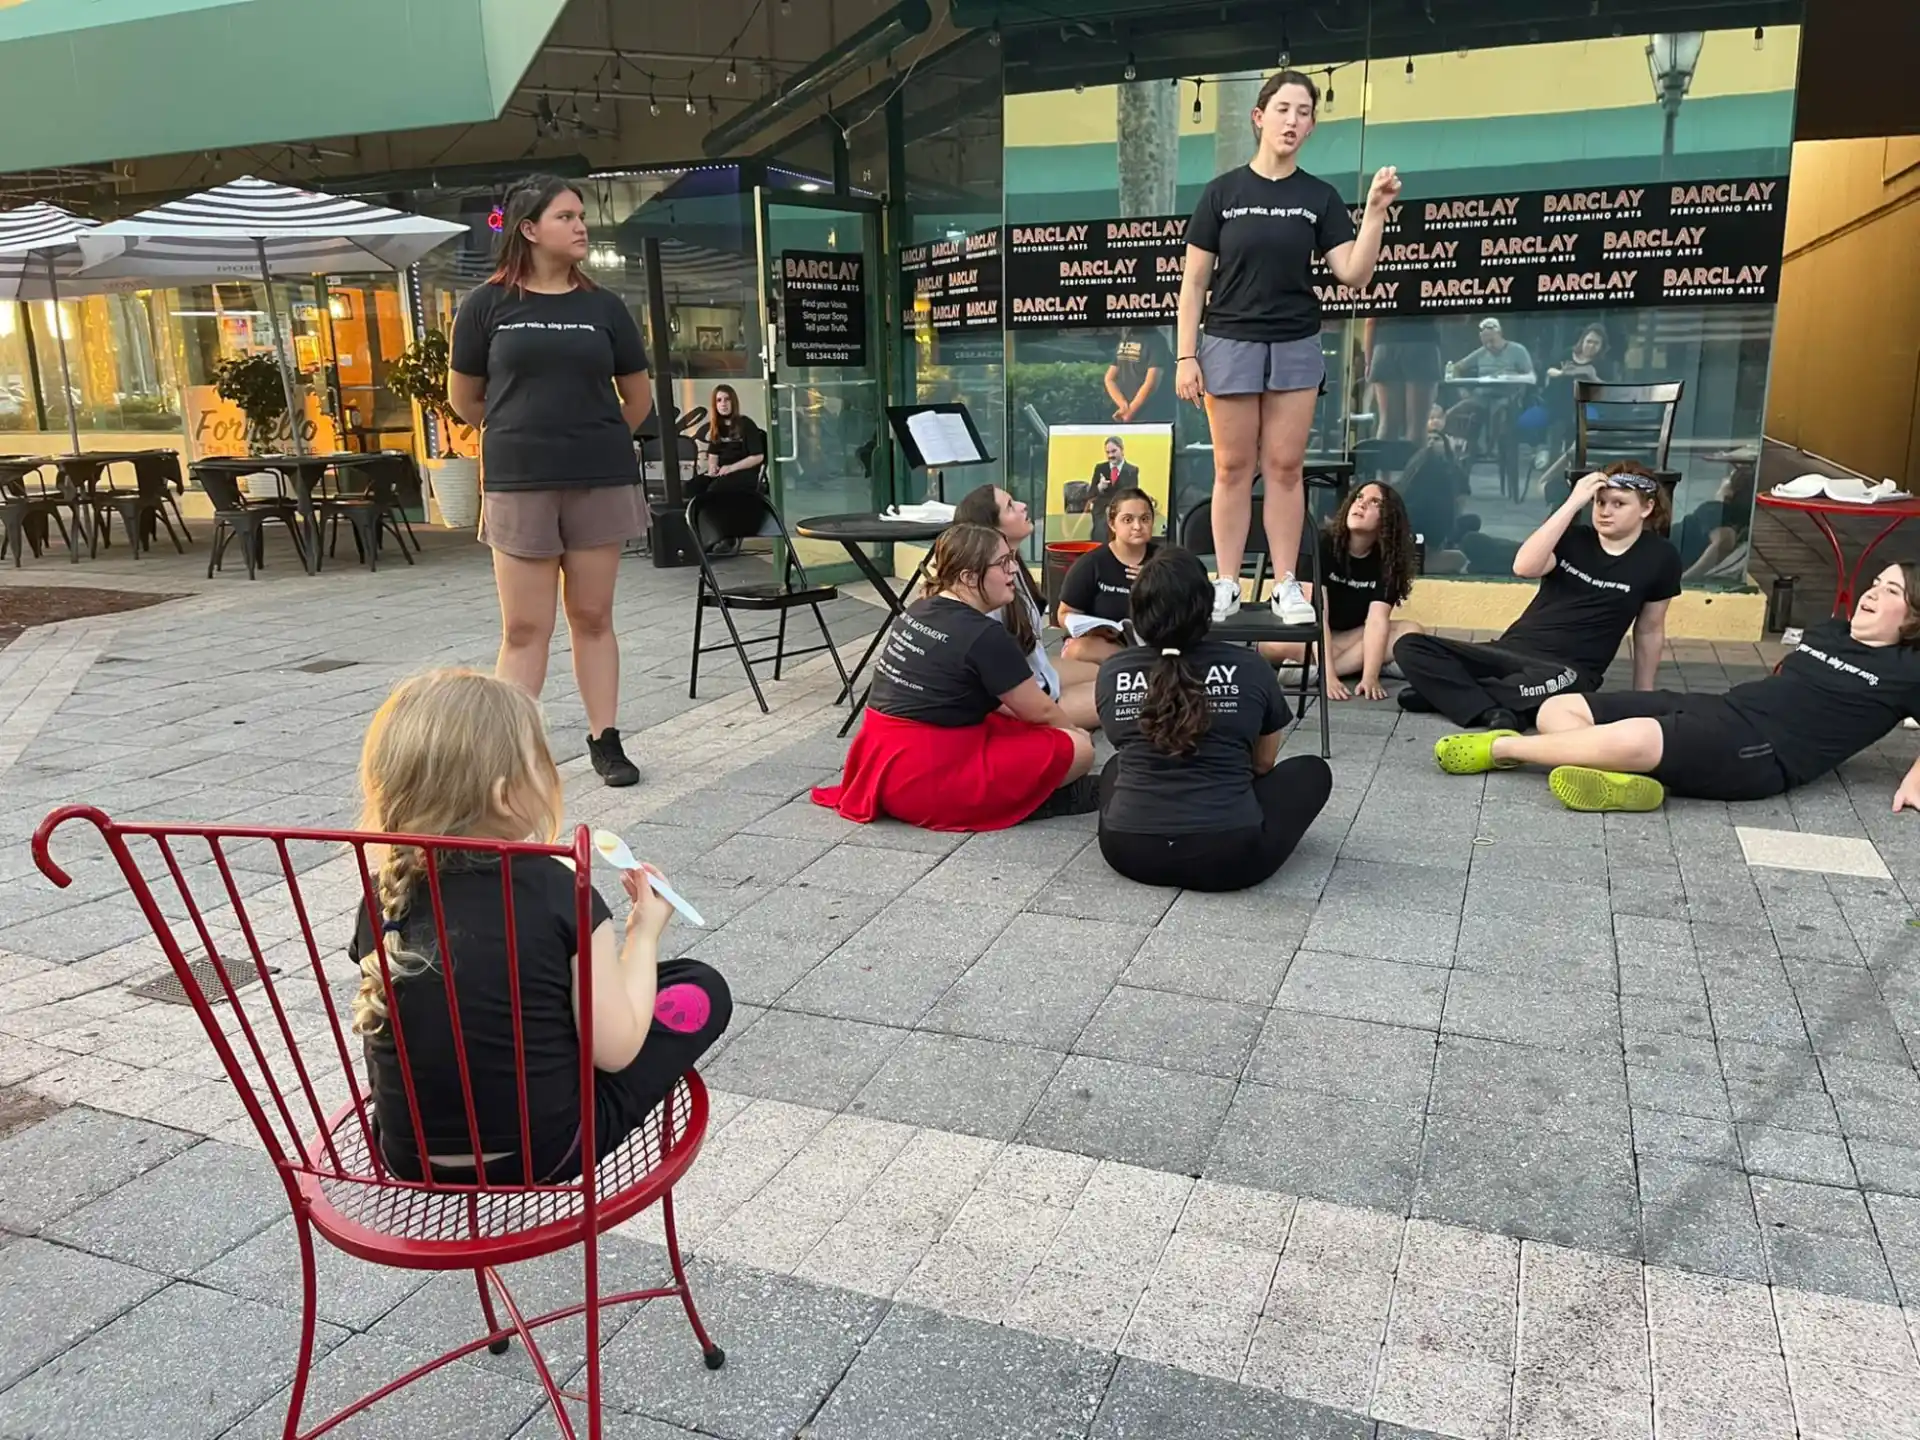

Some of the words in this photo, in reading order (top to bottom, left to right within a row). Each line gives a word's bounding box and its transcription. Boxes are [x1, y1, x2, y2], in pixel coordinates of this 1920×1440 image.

[1670, 182, 1776, 205] BARCLAY
[1544, 189, 1645, 213] BARCLAY
[1425, 197, 1520, 221] BARCLAY
[1670, 205, 1741, 216] PERFORMING
[1746, 203, 1773, 212] ARTS
[1543, 211, 1611, 223] PERFORMING
[1616, 209, 1642, 219] ARTS
[1107, 220, 1186, 239] BARCLAY
[1425, 219, 1488, 231] PERFORMING
[1493, 217, 1517, 226] ARTS
[1013, 225, 1088, 244] BARCLAY
[1603, 226, 1707, 250] BARCLAY
[1013, 244, 1064, 253] PERFORMING
[1068, 243, 1088, 251] ARTS
[1107, 239, 1161, 248] PERFORMING
[1481, 233, 1579, 257] BARCLAY
[1378, 241, 1459, 262] ARCLAY
[1602, 249, 1672, 260] PERFORMING
[1677, 248, 1703, 257] ARTS
[1433, 261, 1457, 269] ARTS
[1480, 255, 1546, 267] PERFORMING
[1550, 253, 1576, 263] ARTS
[785, 258, 859, 280] BARCLAY
[1060, 258, 1137, 277] BARCLAY
[1060, 277, 1113, 286] PERFORMING
[1116, 276, 1137, 284] ARTS
[1537, 270, 1638, 293] BARCLAY
[1663, 265, 1768, 287] BARCLAY
[787, 281, 838, 291] PERFORMING
[841, 284, 860, 292] ARTS
[1420, 276, 1514, 298] BARCLAY
[1663, 287, 1733, 297] PERFORMING
[1738, 286, 1765, 294] ARTS
[1420, 297, 1483, 307] PERFORMING
[1488, 296, 1512, 305] ARTS
[1537, 292, 1604, 302] PERFORMING
[1609, 291, 1635, 300] ARTS
[816, 301, 830, 310] your
[1013, 296, 1088, 313] BARCLAY
[1374, 301, 1398, 309] ARTS
[802, 311, 817, 321] Sing
[818, 313, 830, 321] your
[1013, 313, 1064, 322] PERFORMING
[1068, 312, 1088, 321] ARTS
[1106, 311, 1160, 319] PERFORMING
[805, 323, 816, 331] Tell
[816, 325, 830, 333] your
[1519, 684, 1546, 697] Team
